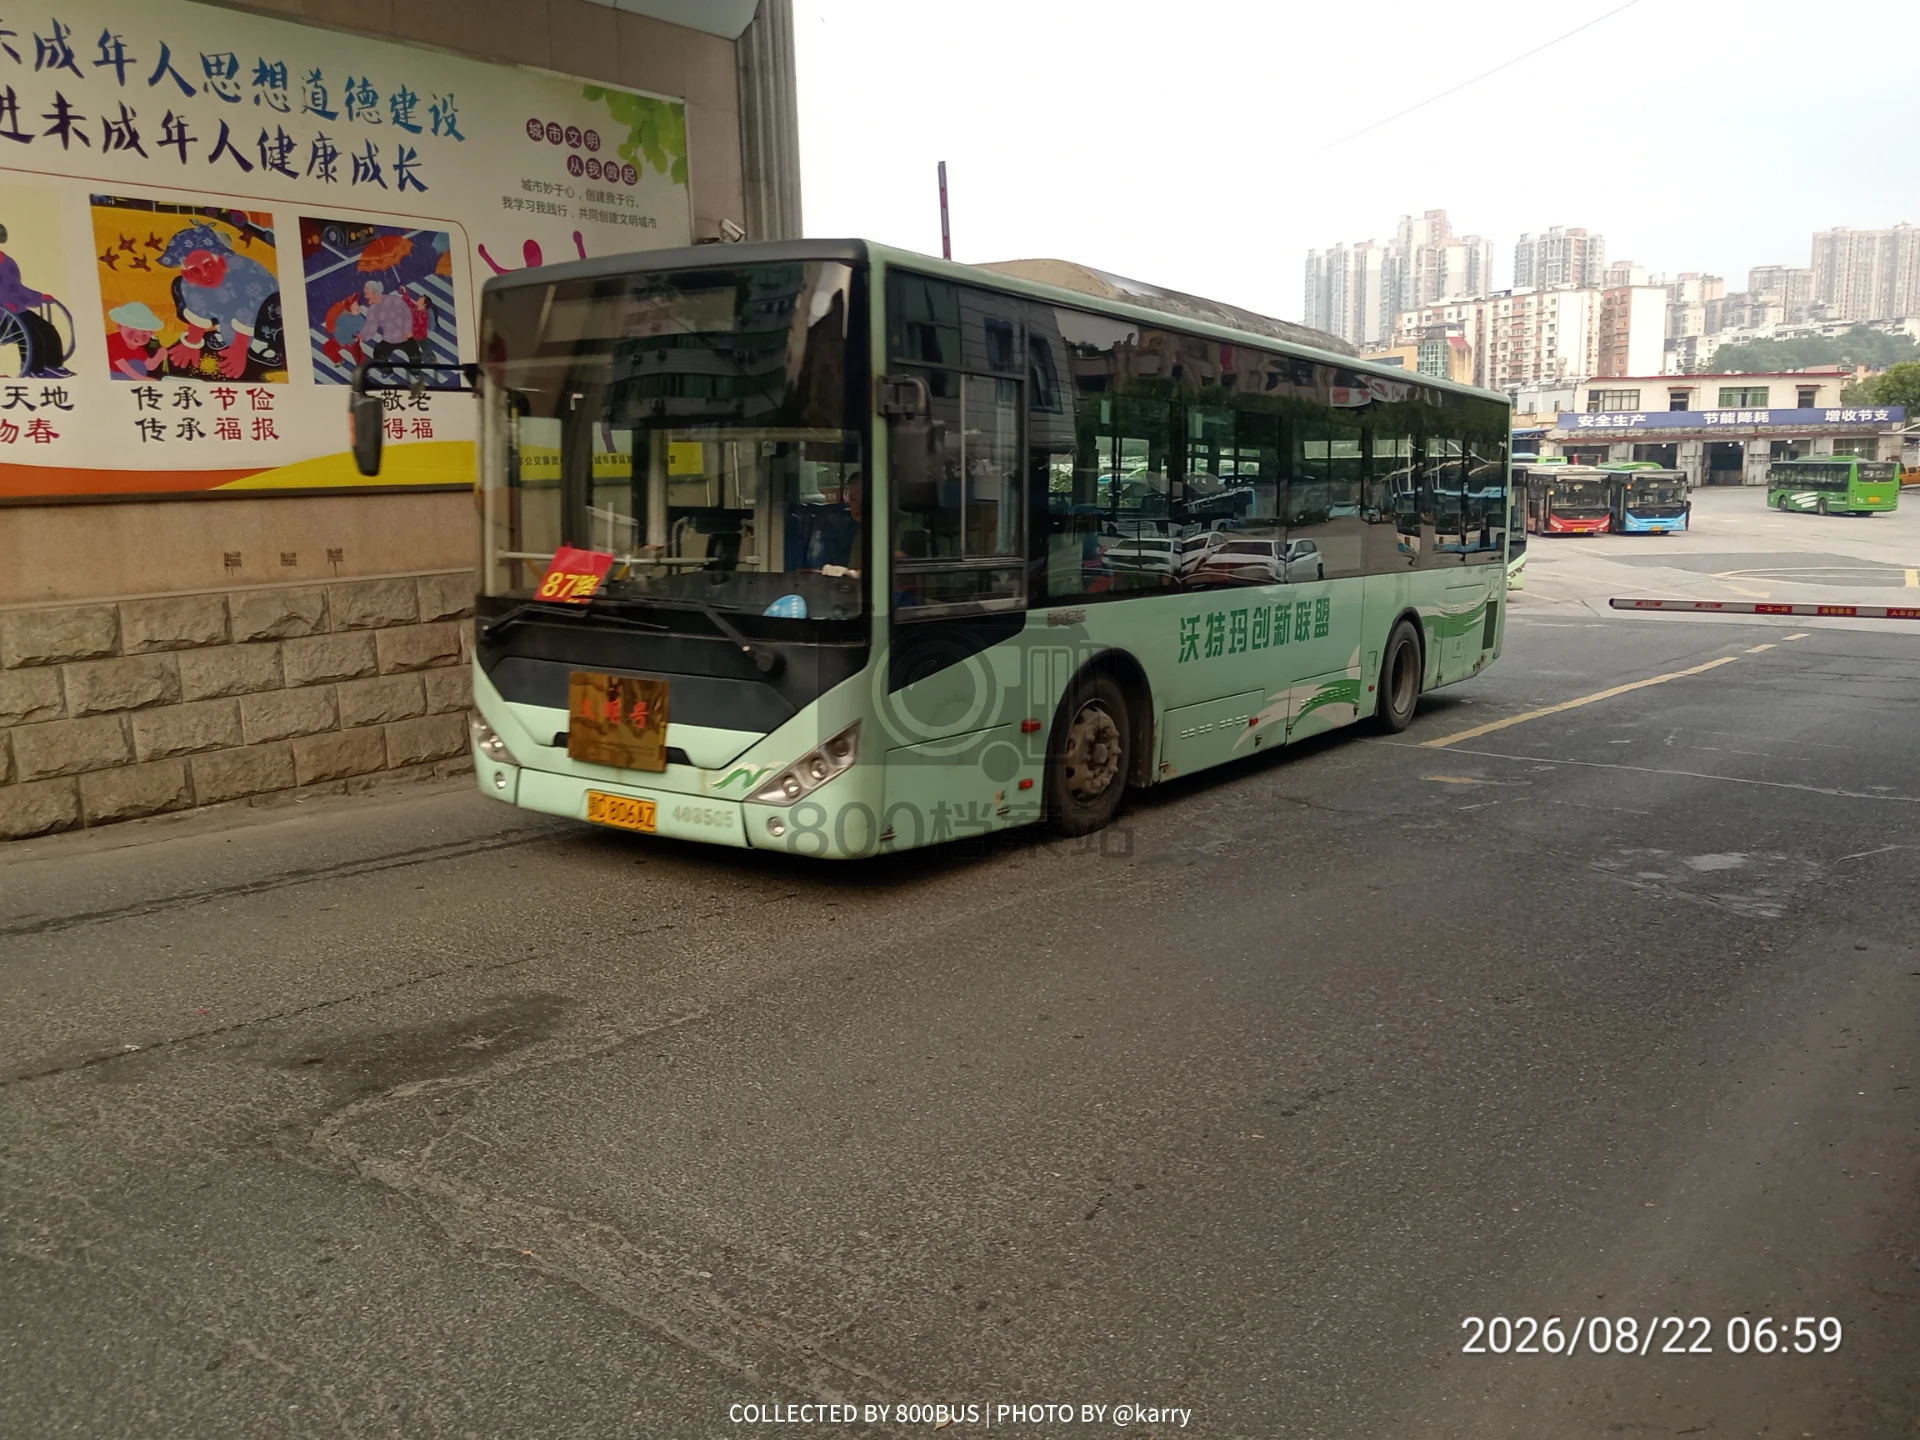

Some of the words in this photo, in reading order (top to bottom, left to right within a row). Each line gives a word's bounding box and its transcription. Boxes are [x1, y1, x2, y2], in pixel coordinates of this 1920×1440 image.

[528, 120, 601, 151] 城市文明
[567, 156, 637, 185] 从我做起
[1, 386, 75, 412] 天地
[131, 386, 275, 411] 传承节俭
[381, 389, 432, 411] 敬老
[135, 416, 280, 442] 传承福报
[383, 418, 433, 439] 得福
[1577, 414, 1647, 428] 安全生产
[1703, 411, 1770, 425] 节能降耗
[1824, 409, 1889, 423] 增收节支
[541, 572, 600, 597] 87路
[1178, 597, 1331, 663] 沃特玛创新联盟
